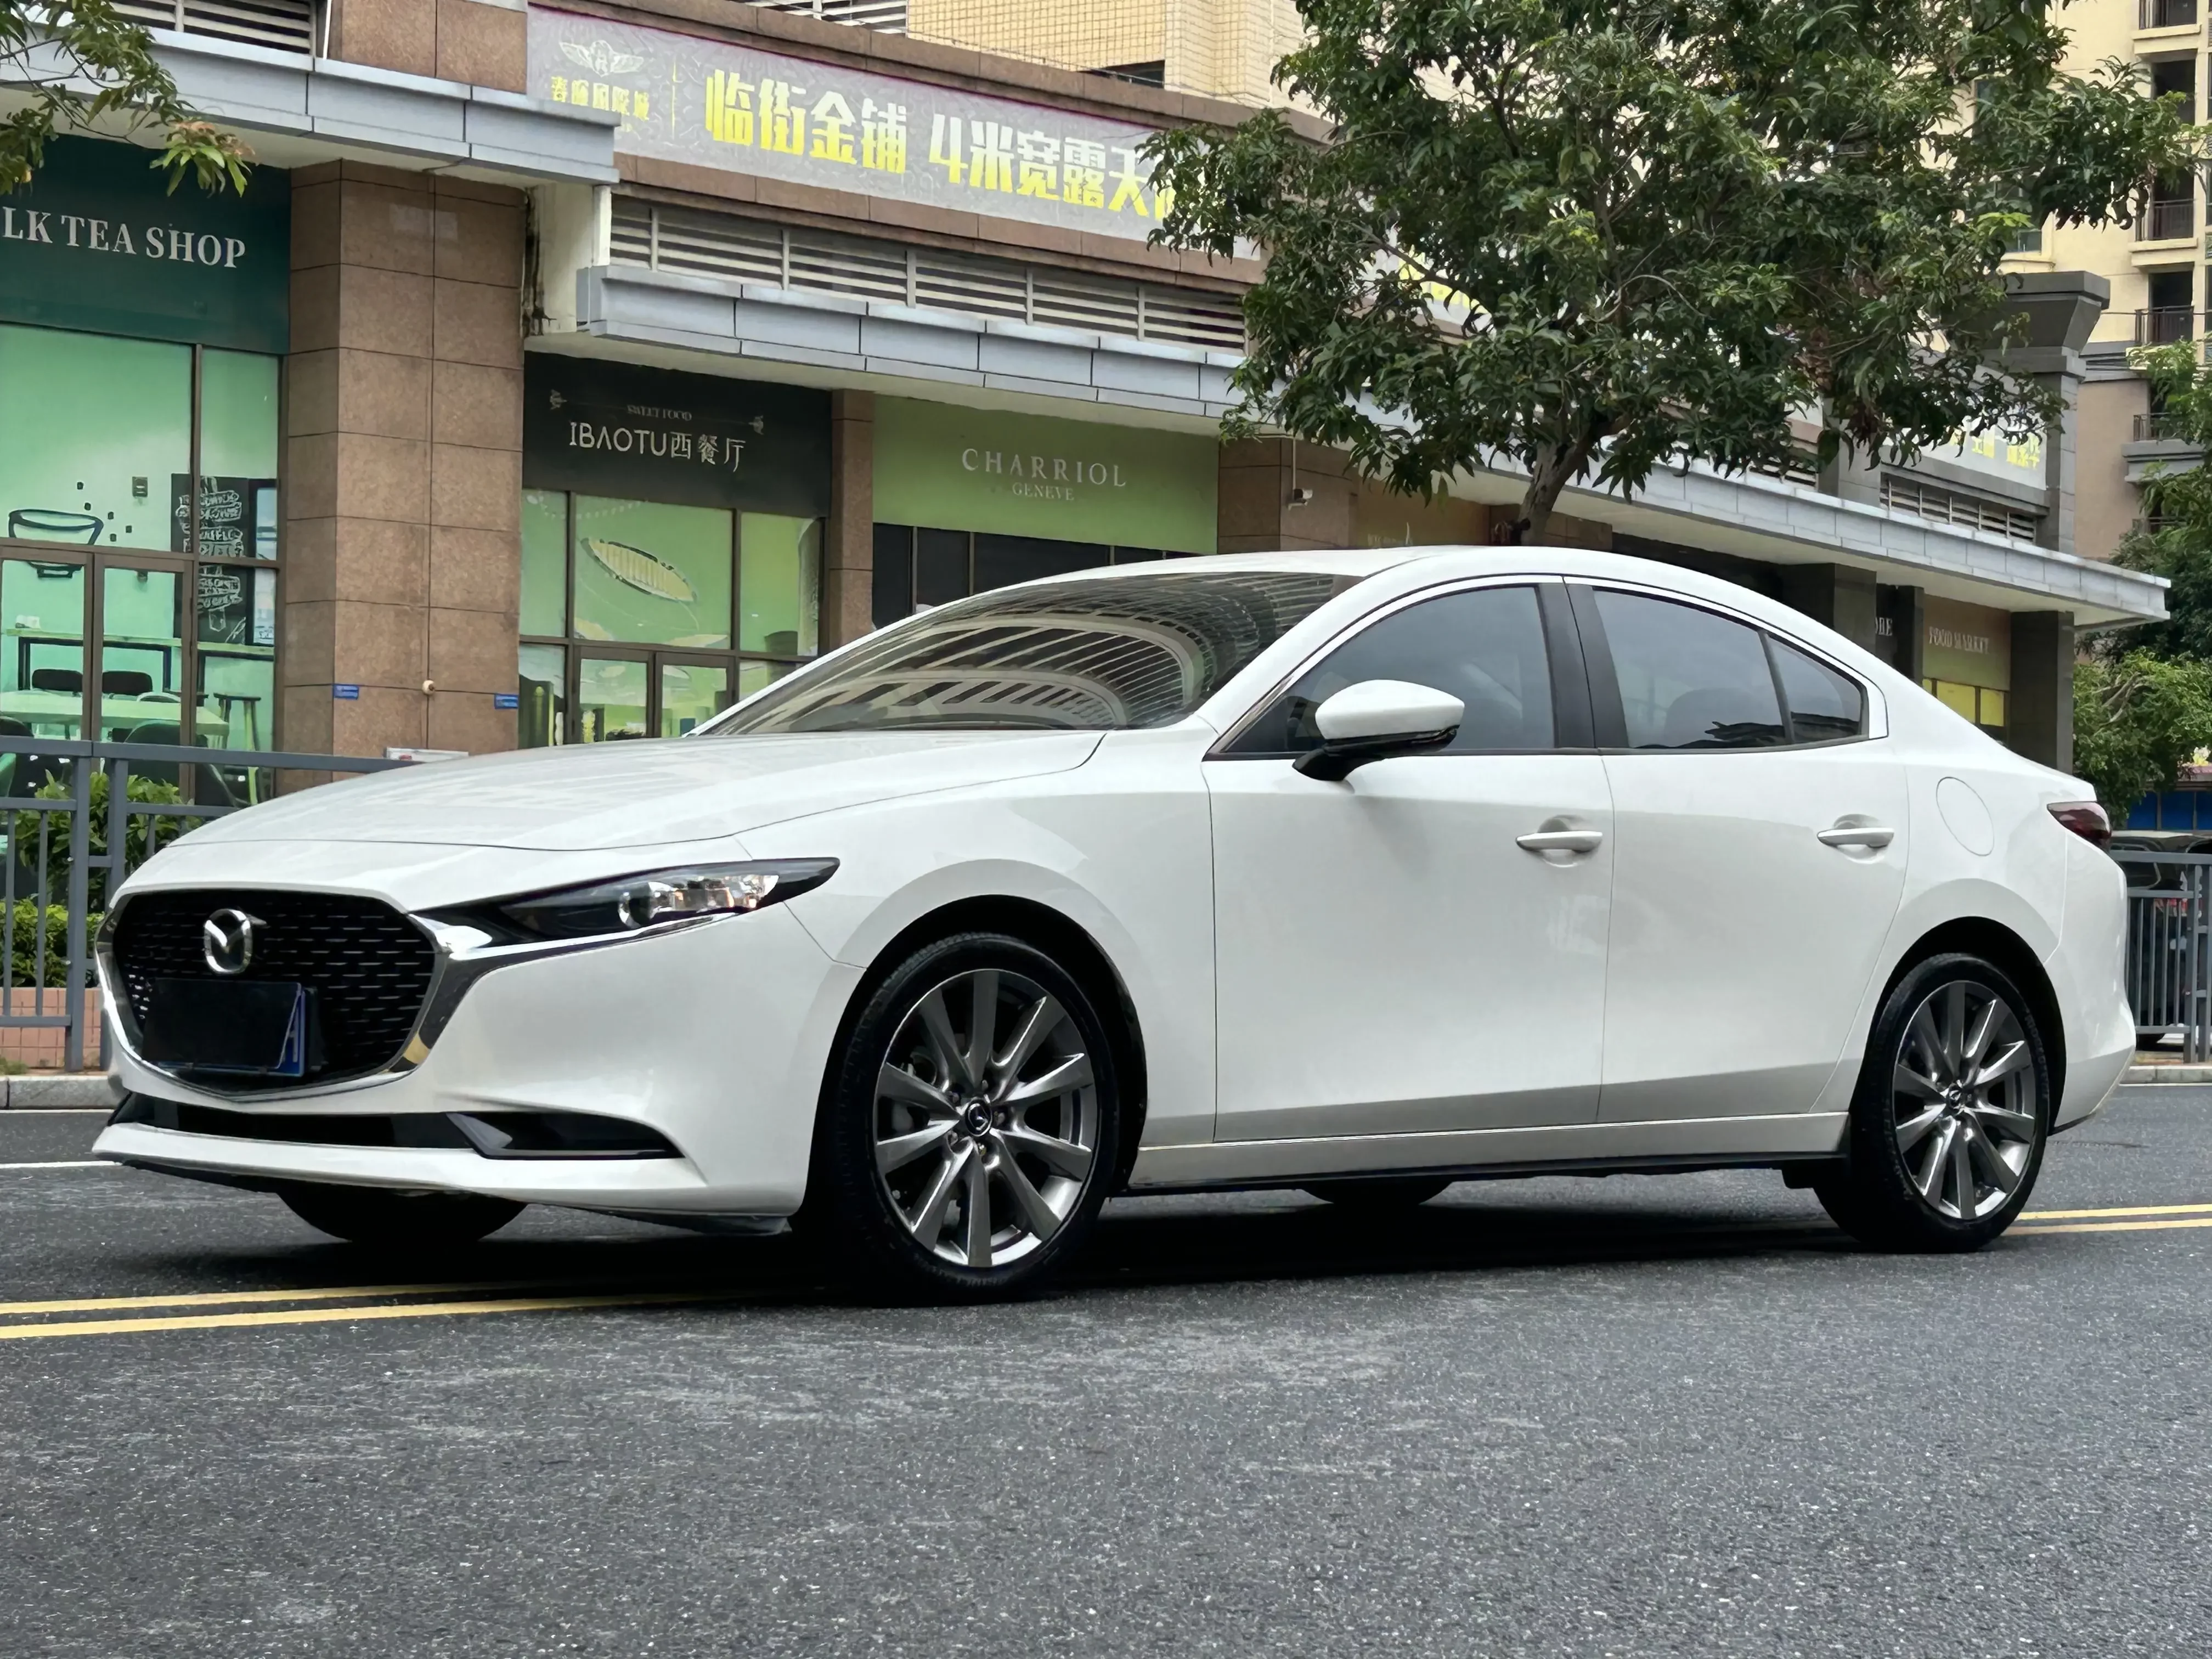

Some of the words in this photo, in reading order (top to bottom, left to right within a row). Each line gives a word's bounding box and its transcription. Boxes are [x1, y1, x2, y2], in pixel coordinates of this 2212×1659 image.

[705, 69, 906, 174] 临街金铺
[929, 114, 1177, 221] 4米宽露天
[2, 206, 53, 244] LK
[60, 215, 137, 255] TEA
[145, 225, 246, 268] SHOP
[962, 448, 1126, 487] CHARRIOL
[1012, 481, 1075, 501] GENEVE
